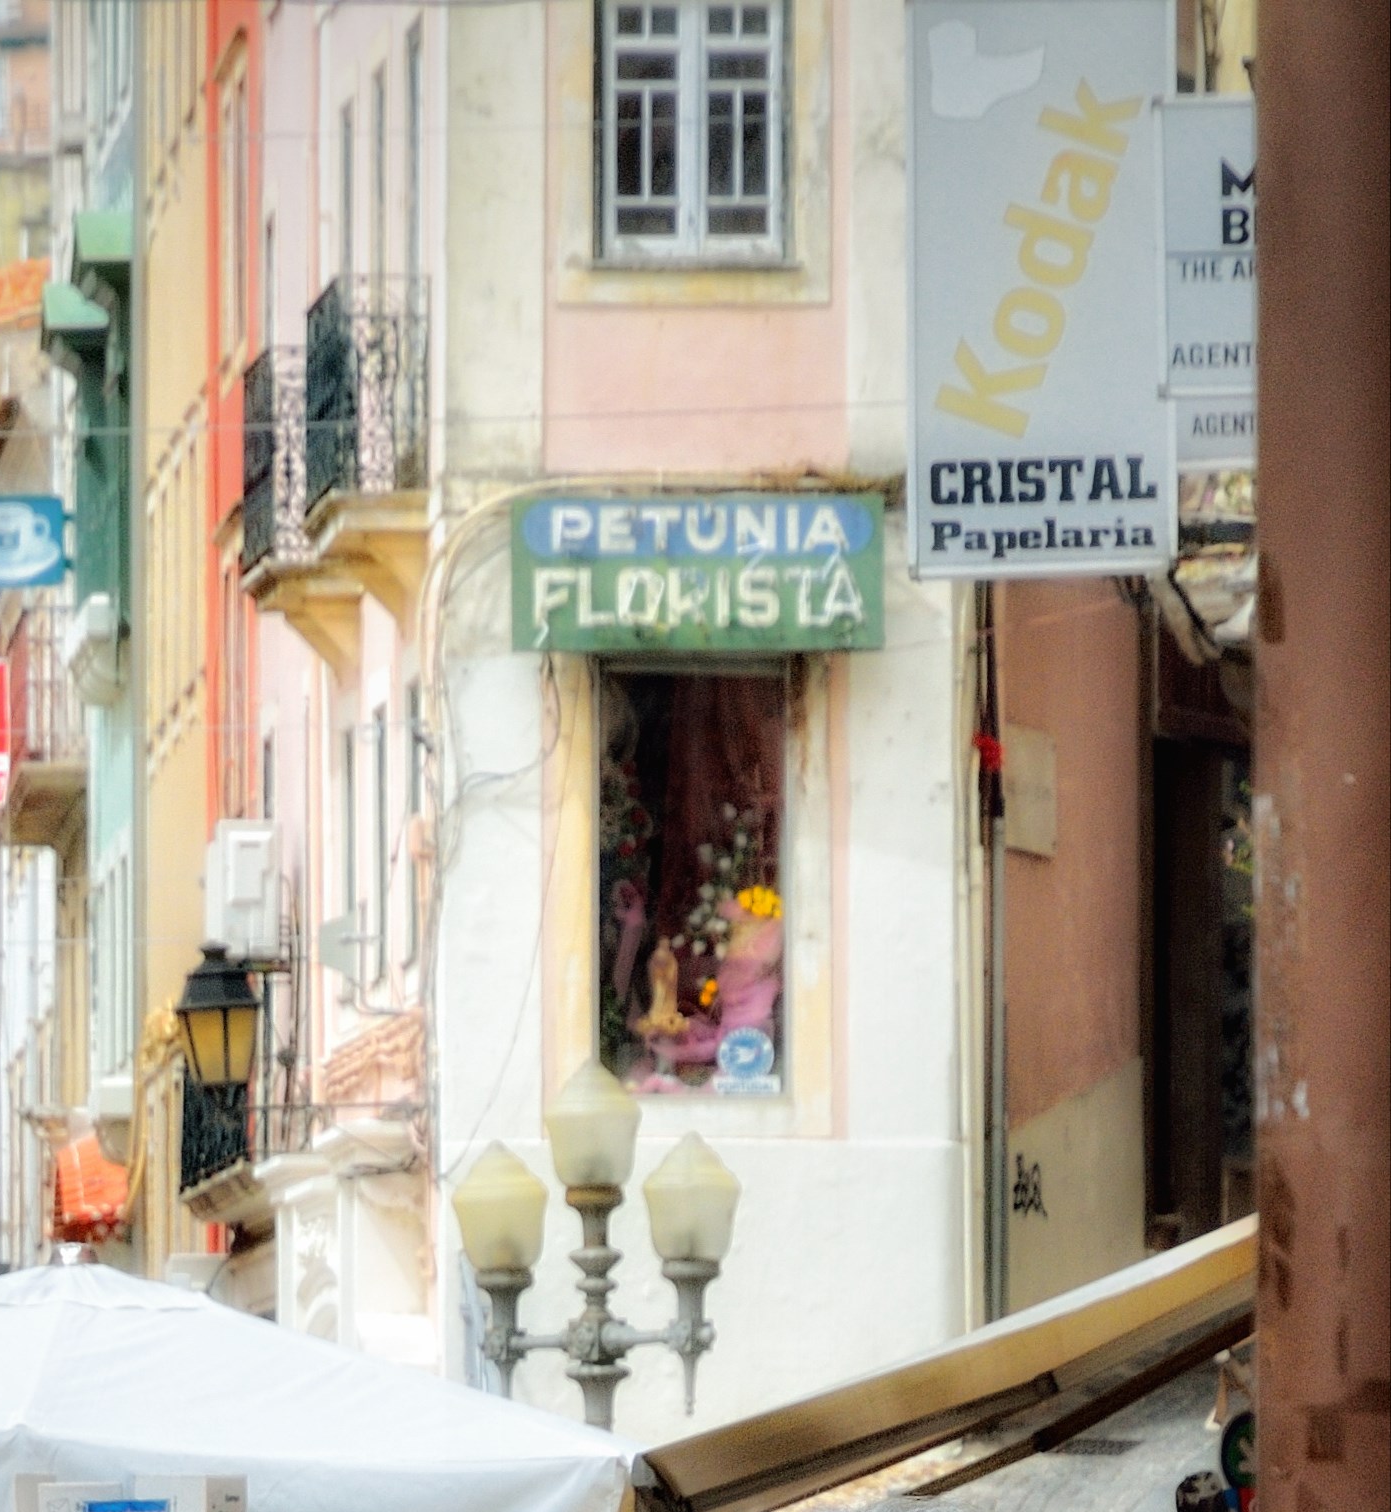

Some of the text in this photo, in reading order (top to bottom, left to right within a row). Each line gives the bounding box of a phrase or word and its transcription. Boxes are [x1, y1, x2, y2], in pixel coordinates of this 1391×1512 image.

[934, 77, 1143, 439] Kodak
[1179, 258, 1223, 282] THE
[930, 455, 1157, 505] CRISTAL
[931, 517, 1156, 558] Papelaria
[533, 560, 863, 629] FLORISTA
